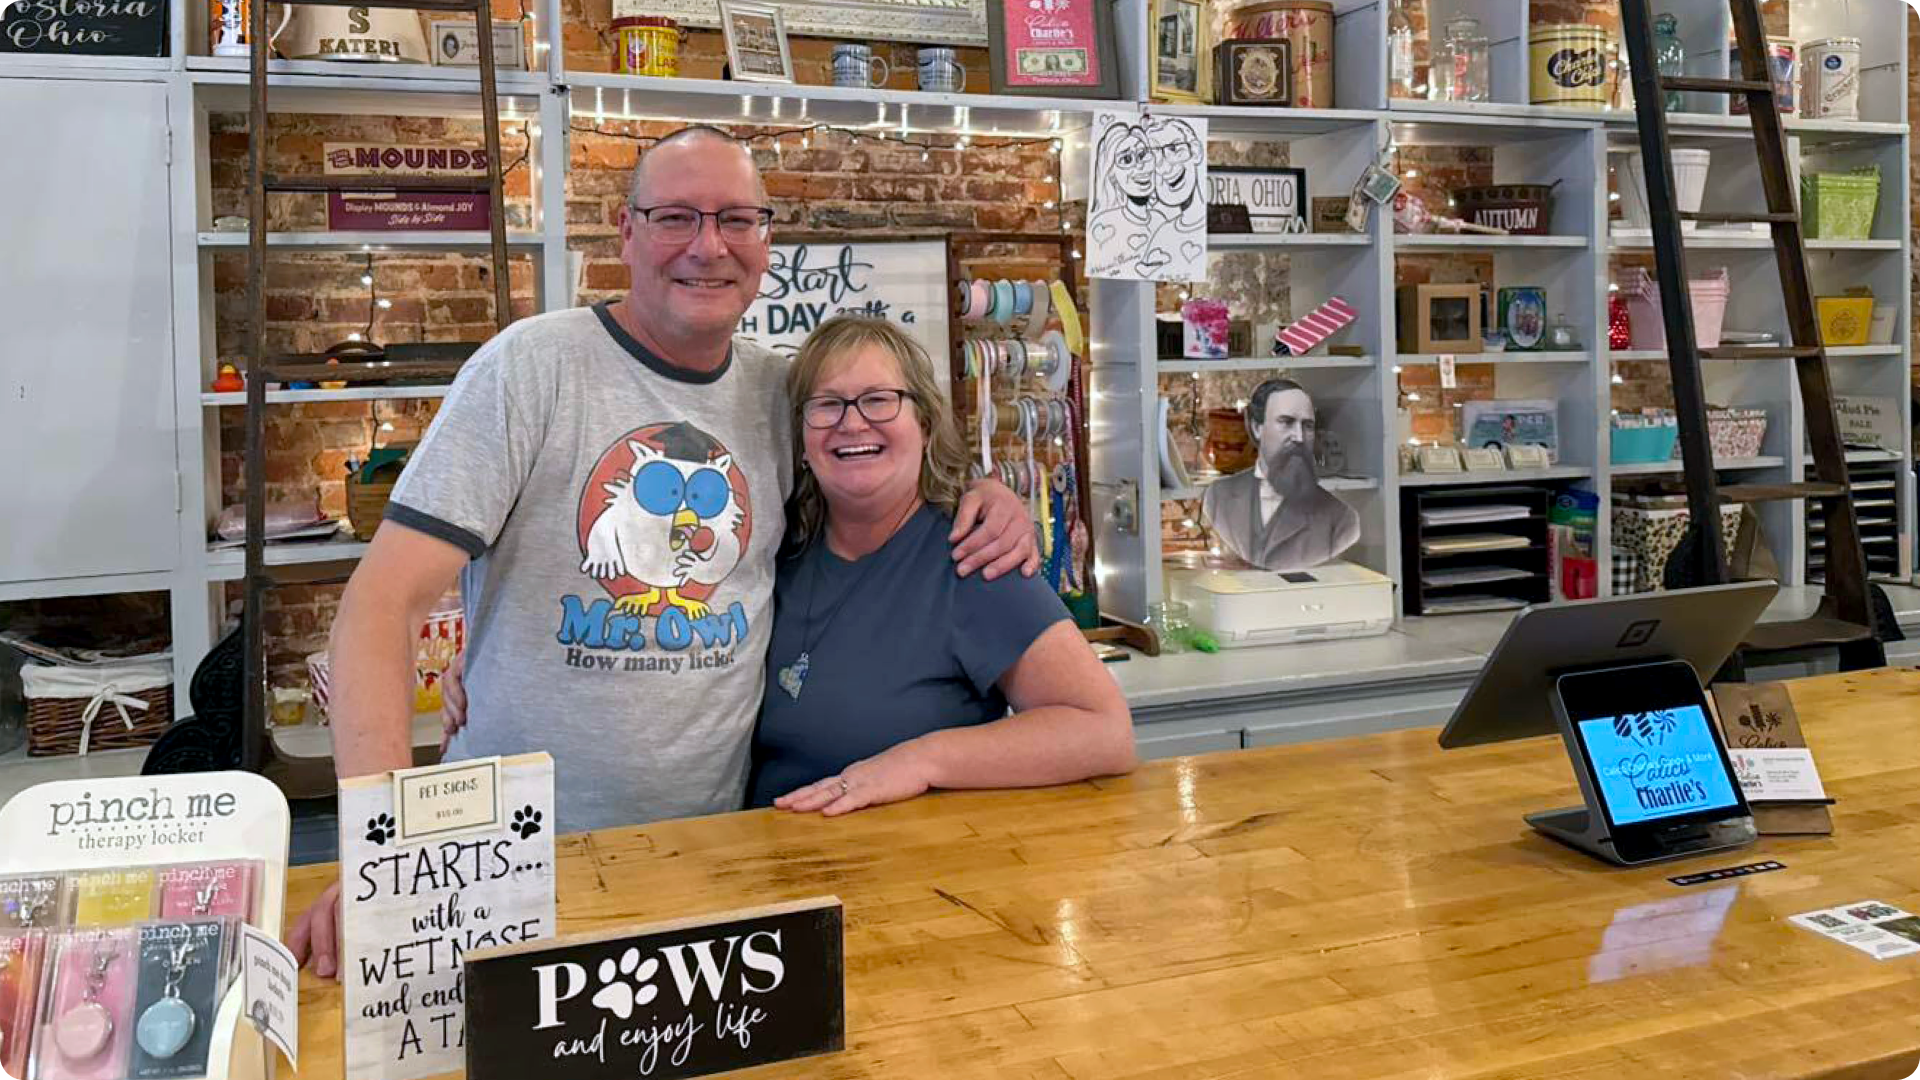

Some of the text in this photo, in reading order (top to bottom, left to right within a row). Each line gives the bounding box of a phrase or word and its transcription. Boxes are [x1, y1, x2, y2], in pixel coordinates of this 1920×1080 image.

[0, 0, 154, 21] ostoria
[7, 19, 112, 48] Ohio
[319, 38, 400, 56] KATERI
[355, 147, 489, 170] MOUNDS
[456, 202, 474, 213] JOY
[1251, 178, 1294, 208] OHIO
[1474, 207, 1539, 230] AUTUMN
[756, 244, 875, 304] Start
[767, 302, 827, 335] DAY
[901, 310, 916, 324] a
[556, 594, 749, 651] Mr. Owl
[566, 647, 619, 671] How
[624, 654, 685, 675] many
[418, 778, 479, 799] PET SIGNS
[1635, 779, 1708, 810] Charlie's
[47, 788, 236, 836] pinch me
[78, 828, 204, 850] therapy locket
[356, 840, 544, 901] STARTS...
[412, 892, 491, 933] with a
[136, 922, 219, 945] pinch me
[359, 936, 443, 986] WET
[362, 982, 411, 1018] and
[397, 1018, 424, 1060] A
[553, 1002, 767, 1076] and enjoy life
